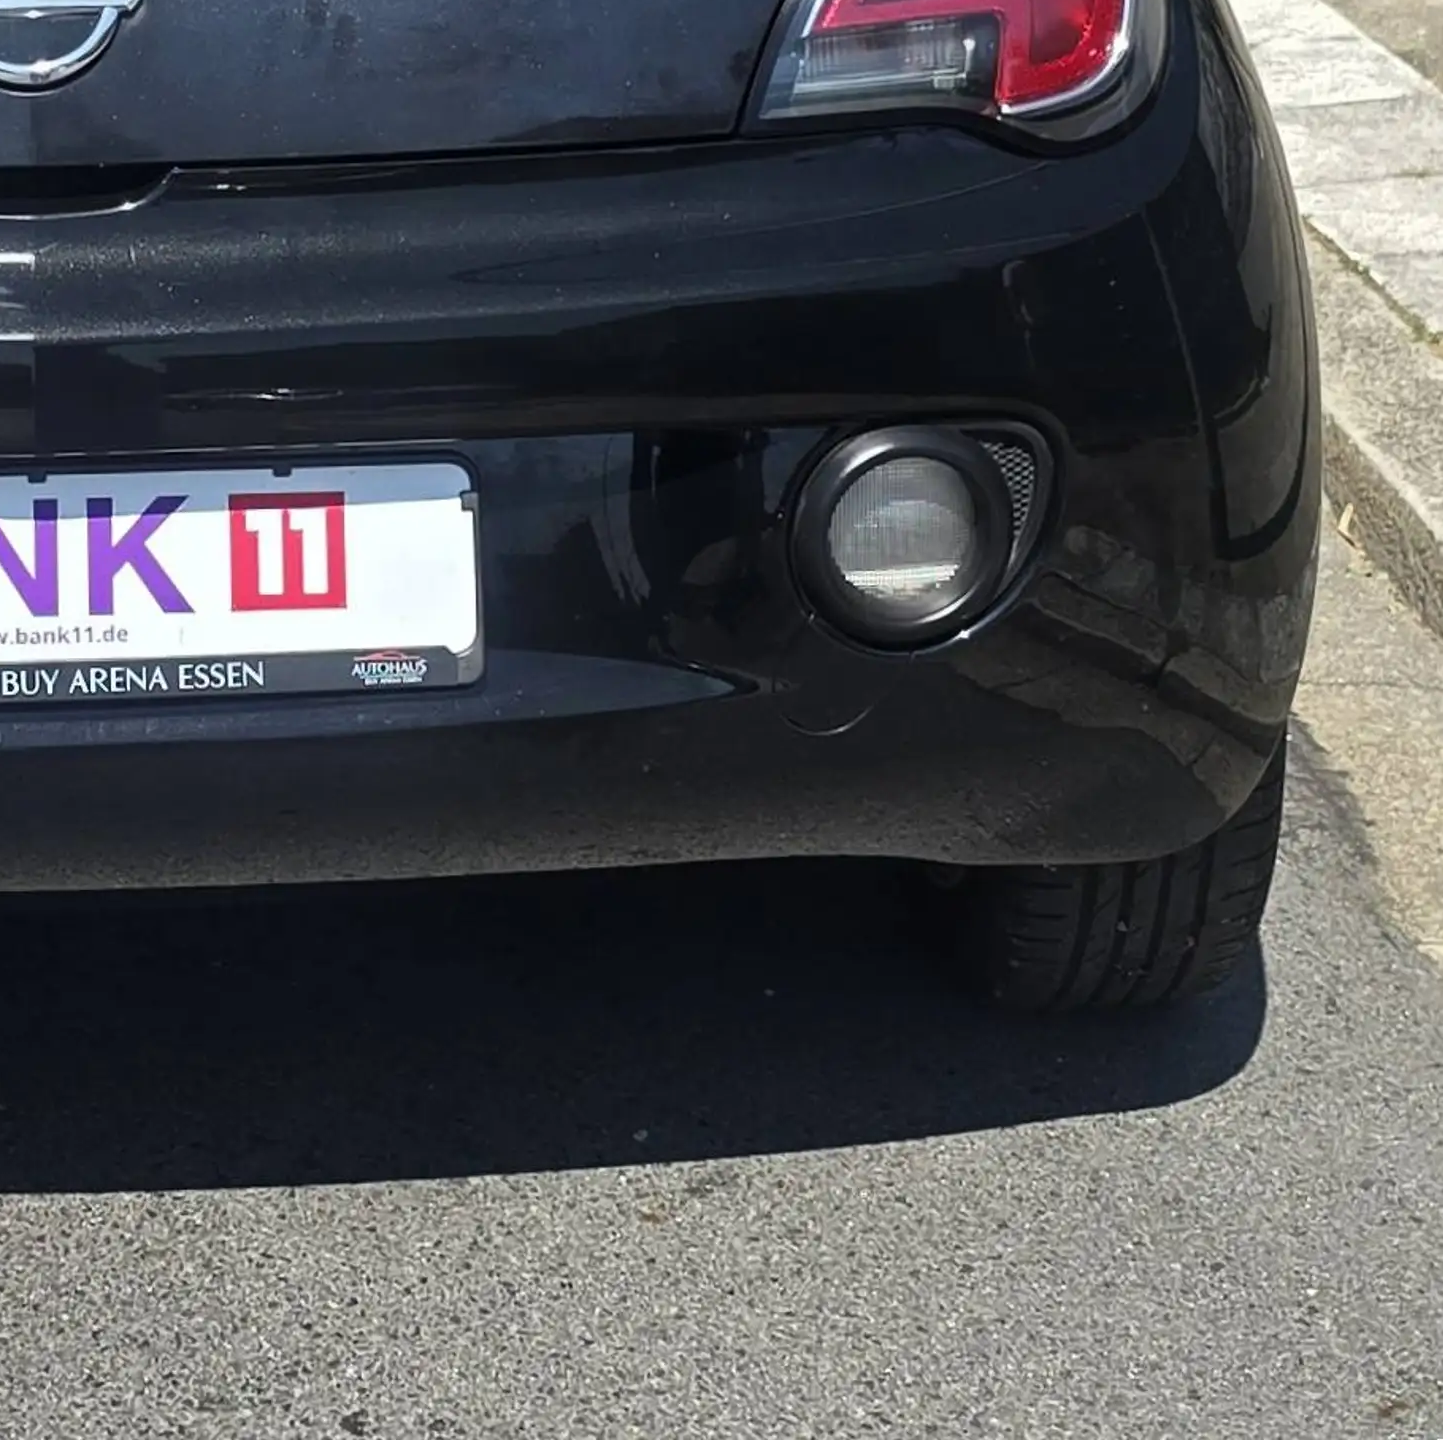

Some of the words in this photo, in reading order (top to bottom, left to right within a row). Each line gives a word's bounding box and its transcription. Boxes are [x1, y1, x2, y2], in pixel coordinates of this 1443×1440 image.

[245, 508, 330, 596] 11
[0, 669, 60, 696] BUY
[69, 665, 168, 694] ARENA
[177, 660, 265, 689] ESSEN
[351, 659, 428, 677] AUTOHAUS
